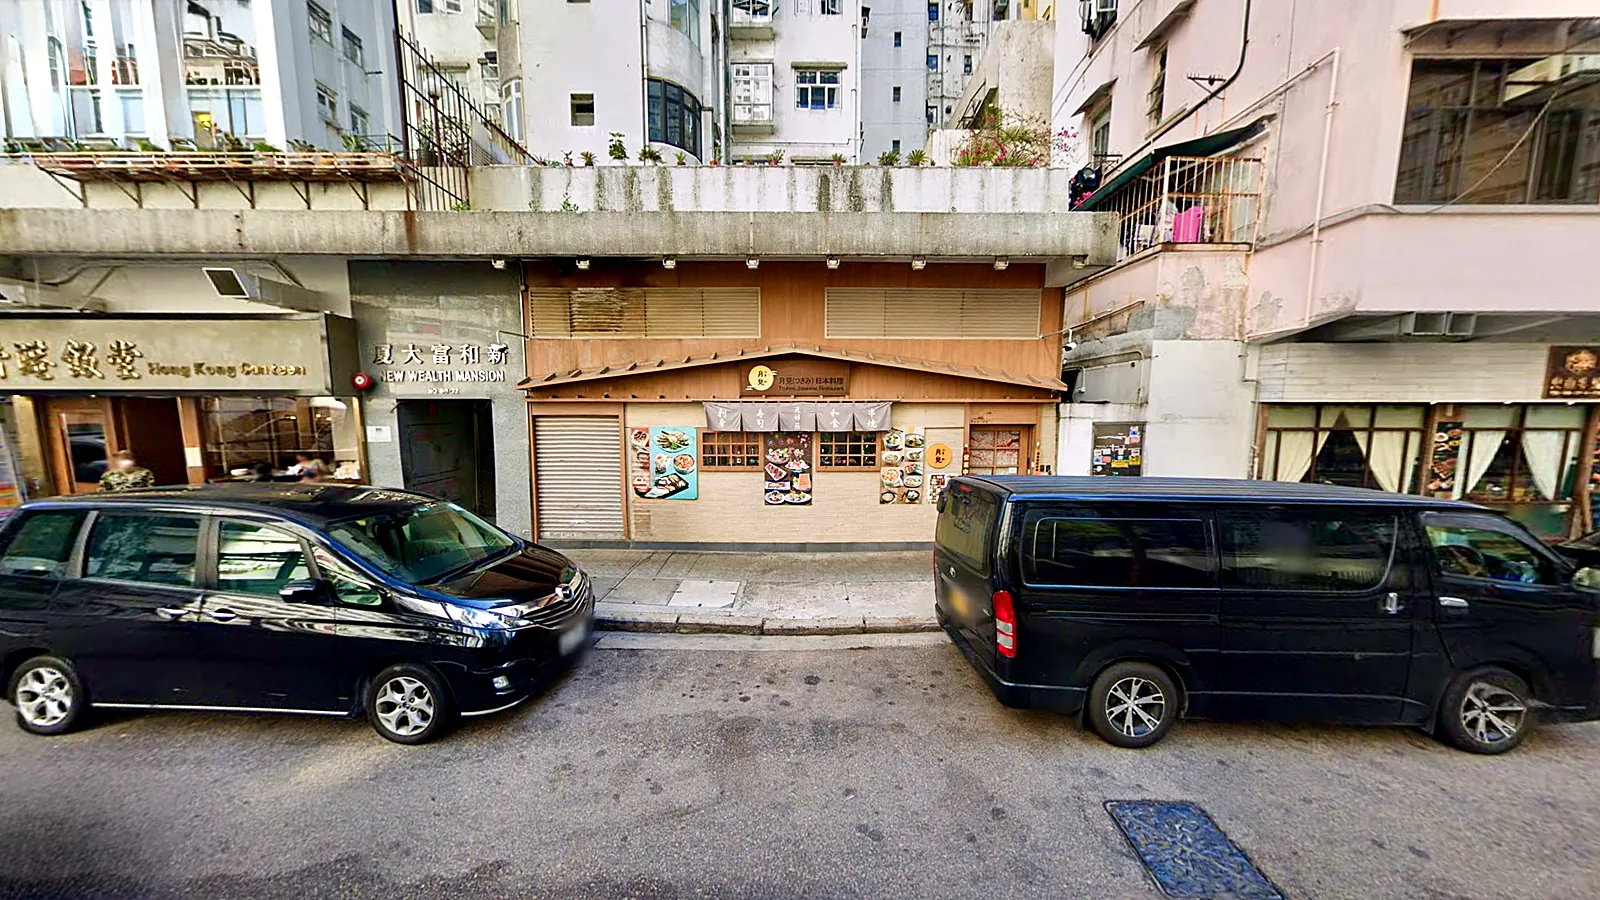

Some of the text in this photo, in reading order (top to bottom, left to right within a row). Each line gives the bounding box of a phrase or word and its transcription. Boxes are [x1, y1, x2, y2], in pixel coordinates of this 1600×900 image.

[0, 339, 144, 380] 港飯堂
[148, 362, 306, 378] Hong Kong Canteen
[381, 370, 505, 382] NEW WEALTH MANSION
[830, 408, 840, 428] 和食
